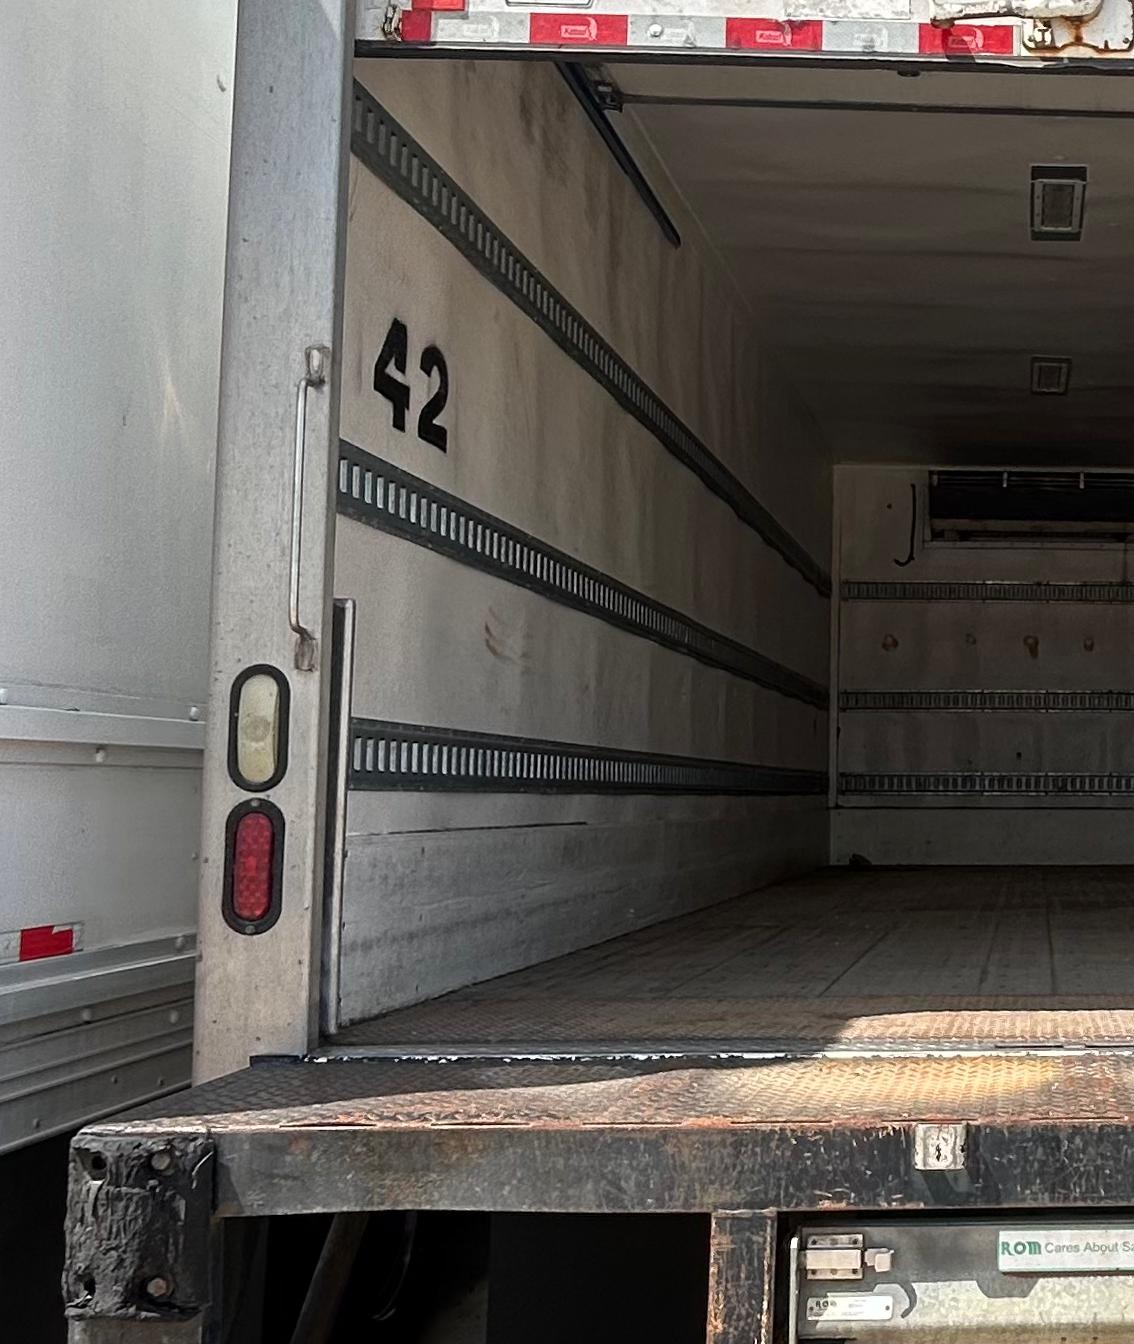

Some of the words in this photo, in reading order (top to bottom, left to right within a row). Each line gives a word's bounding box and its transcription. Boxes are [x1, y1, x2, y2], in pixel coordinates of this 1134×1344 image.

[373, 317, 449, 454] 42
[1044, 1242, 1080, 1254] Cares
[1083, 1241, 1119, 1255] About
